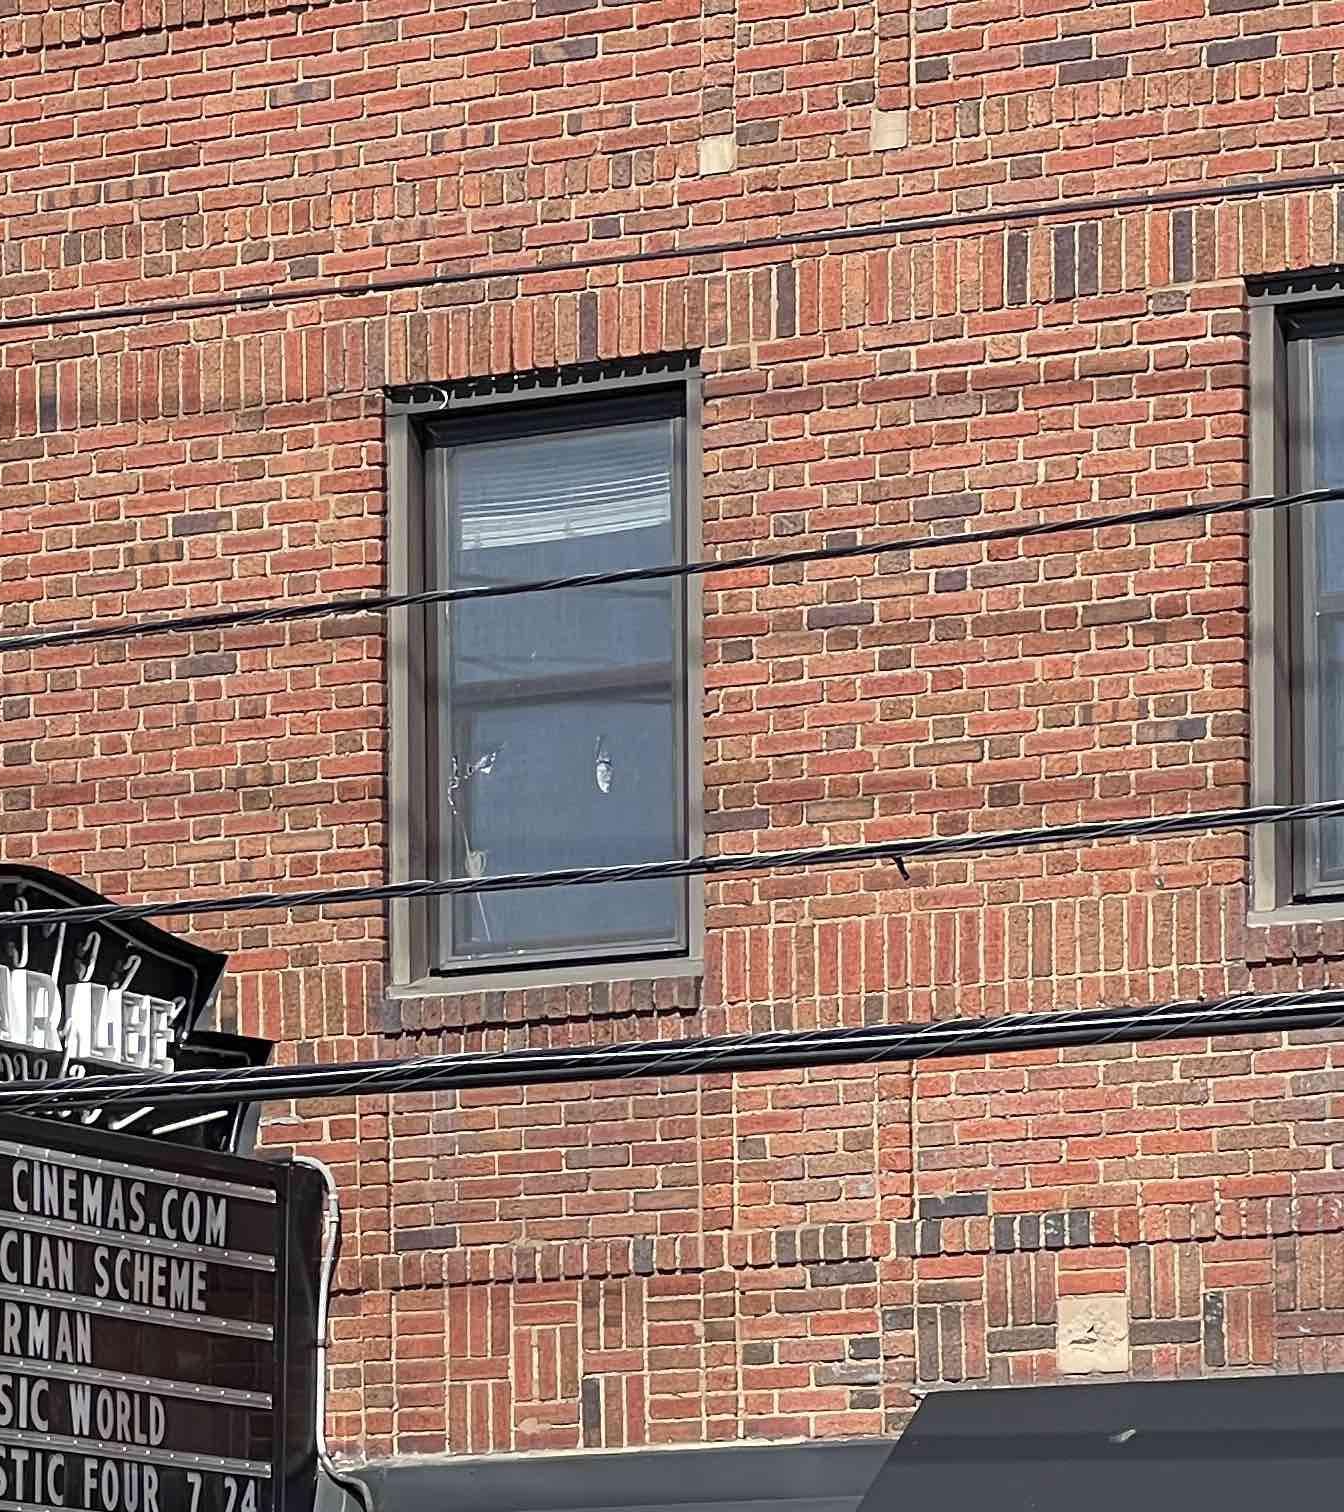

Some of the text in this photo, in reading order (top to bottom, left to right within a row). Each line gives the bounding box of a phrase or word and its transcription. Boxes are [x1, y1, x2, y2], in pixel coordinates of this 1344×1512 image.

[64, 982, 174, 1073] LEE
[12, 1159, 228, 1249] CINEMAS.COM
[94, 1246, 207, 1311] SCHEME
[69, 1390, 166, 1447] WORLD
